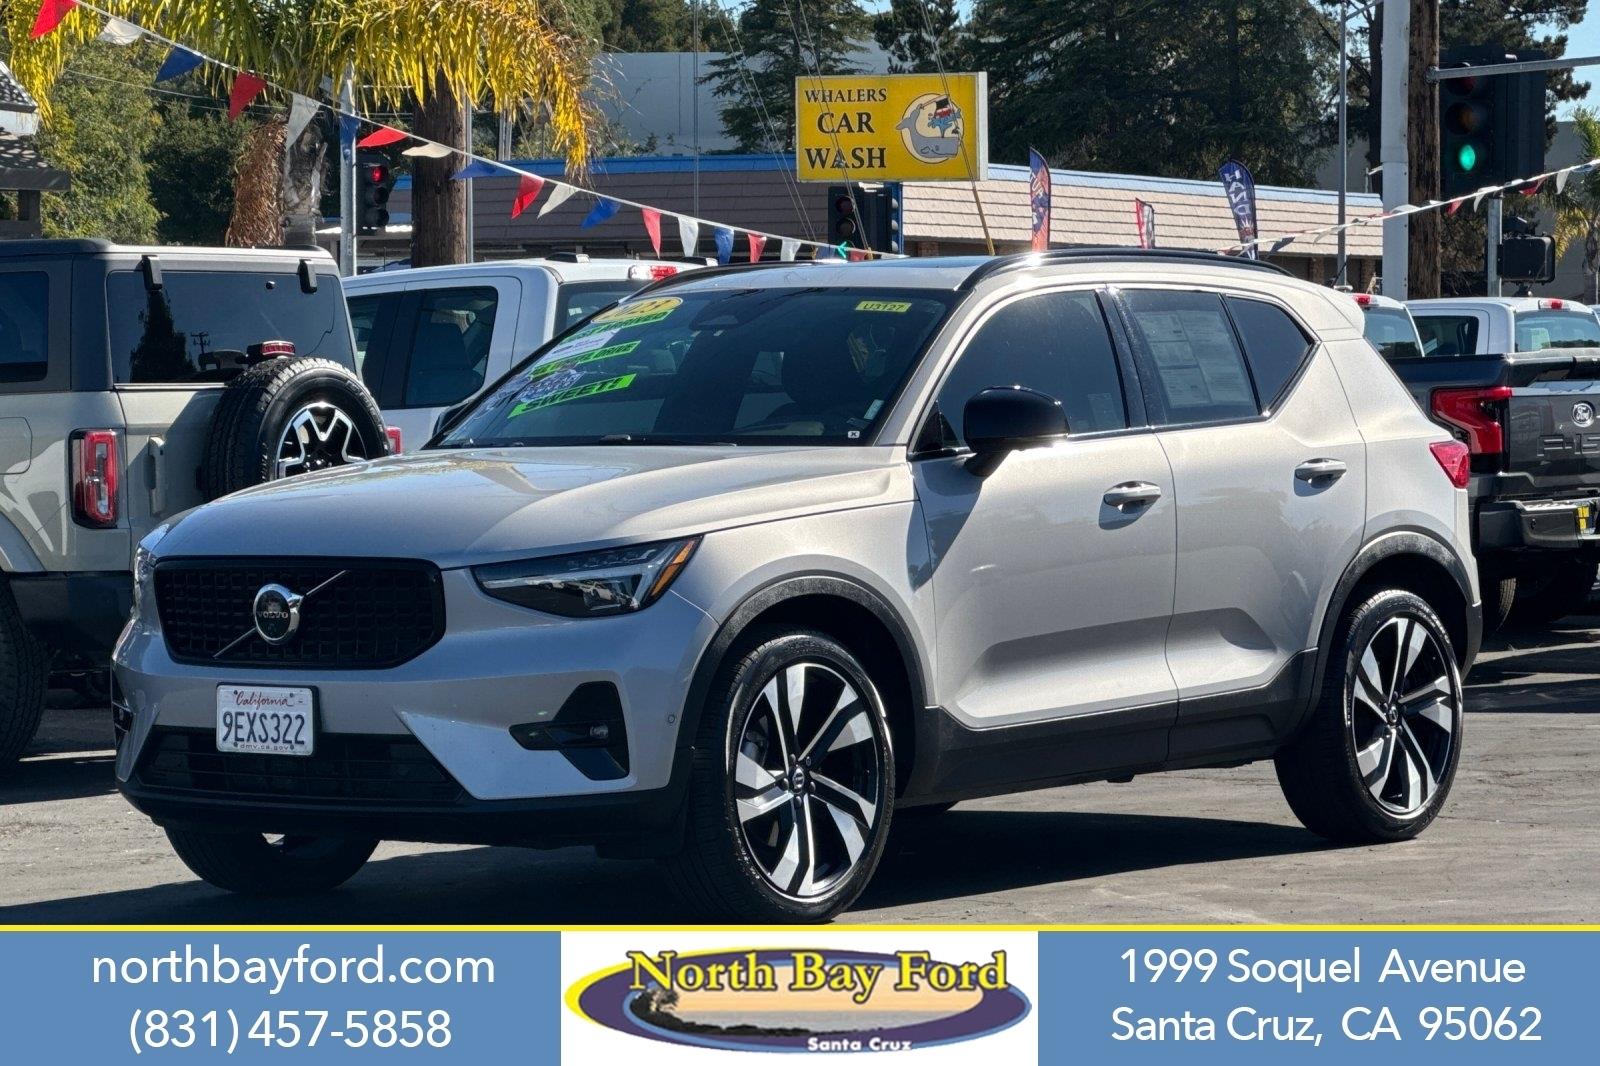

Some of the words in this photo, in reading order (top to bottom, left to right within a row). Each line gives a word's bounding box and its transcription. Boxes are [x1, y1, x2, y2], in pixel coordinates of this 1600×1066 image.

[805, 88, 887, 103] WHALERS
[817, 112, 875, 134] CAR
[805, 147, 887, 169] WASH
[235, 690, 294, 710] California
[222, 711, 305, 745] 9EXS322
[240, 743, 289, 752] dmv.ca.gov
